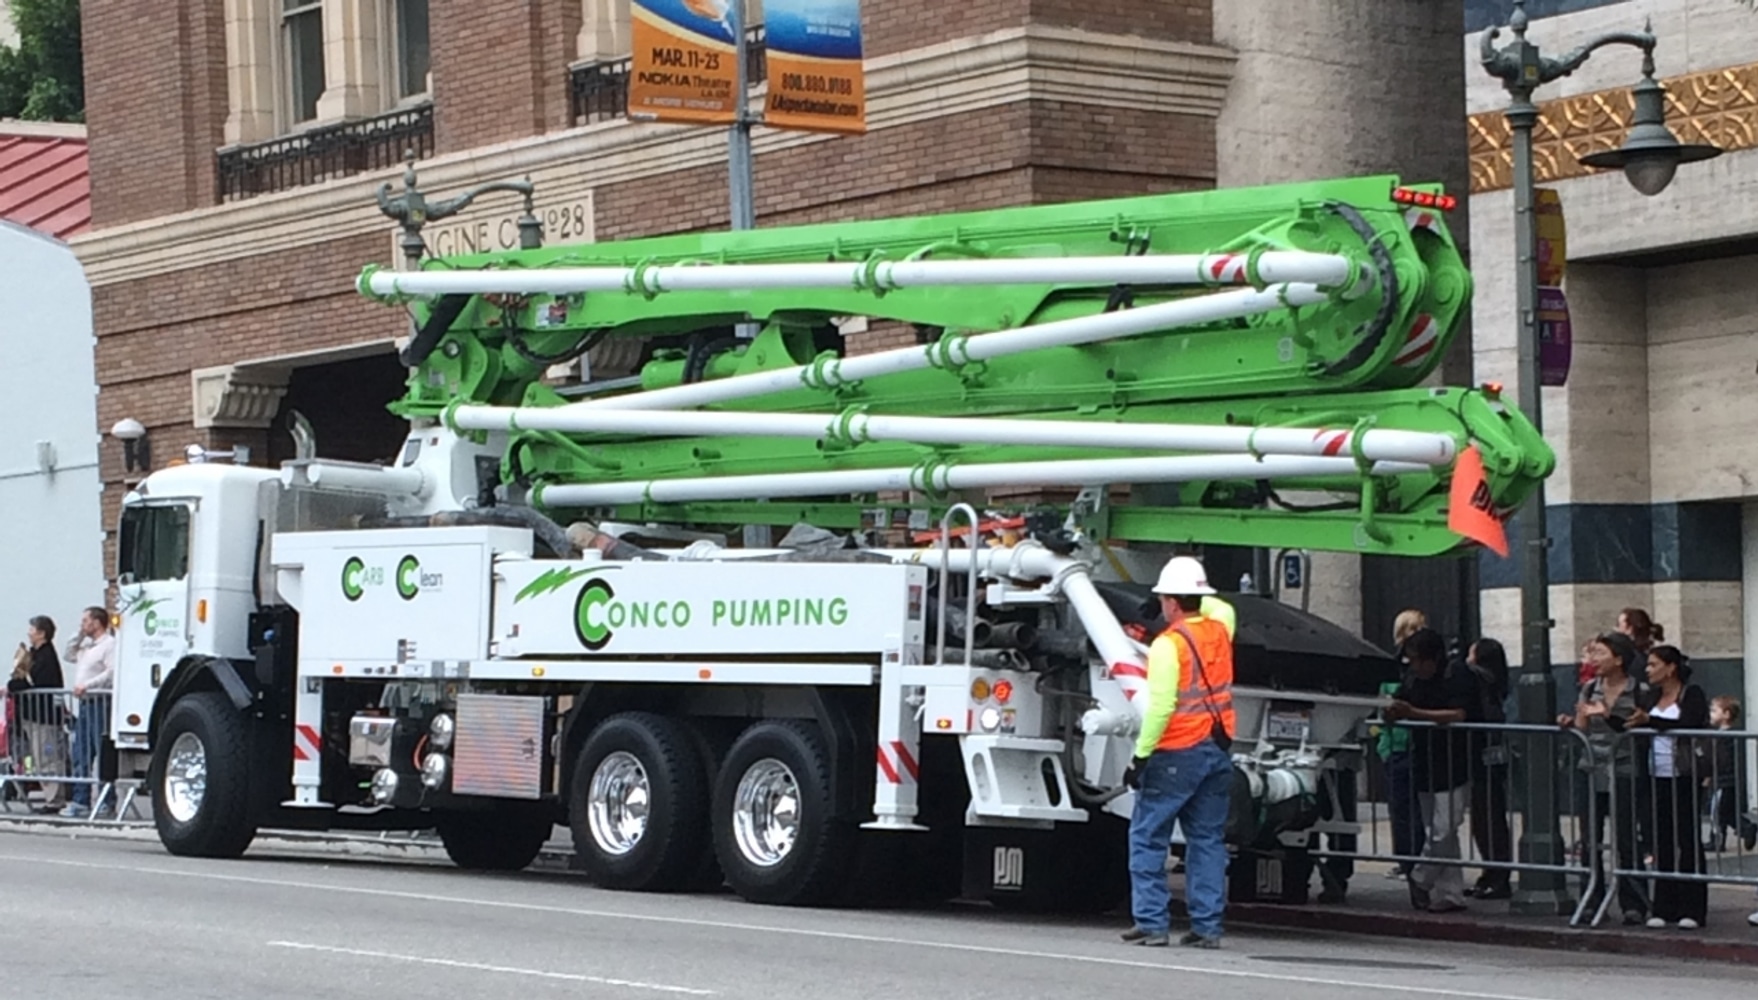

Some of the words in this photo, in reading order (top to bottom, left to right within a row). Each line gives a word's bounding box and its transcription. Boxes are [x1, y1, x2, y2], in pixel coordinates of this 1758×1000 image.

[638, 71, 691, 86] NOKIA
[692, 74, 732, 89] Theatre
[417, 222, 492, 257] NGINE
[341, 556, 384, 602] CARB
[395, 553, 443, 601] Clean
[574, 577, 691, 651] CONCO
[712, 598, 849, 627] PUMPING
